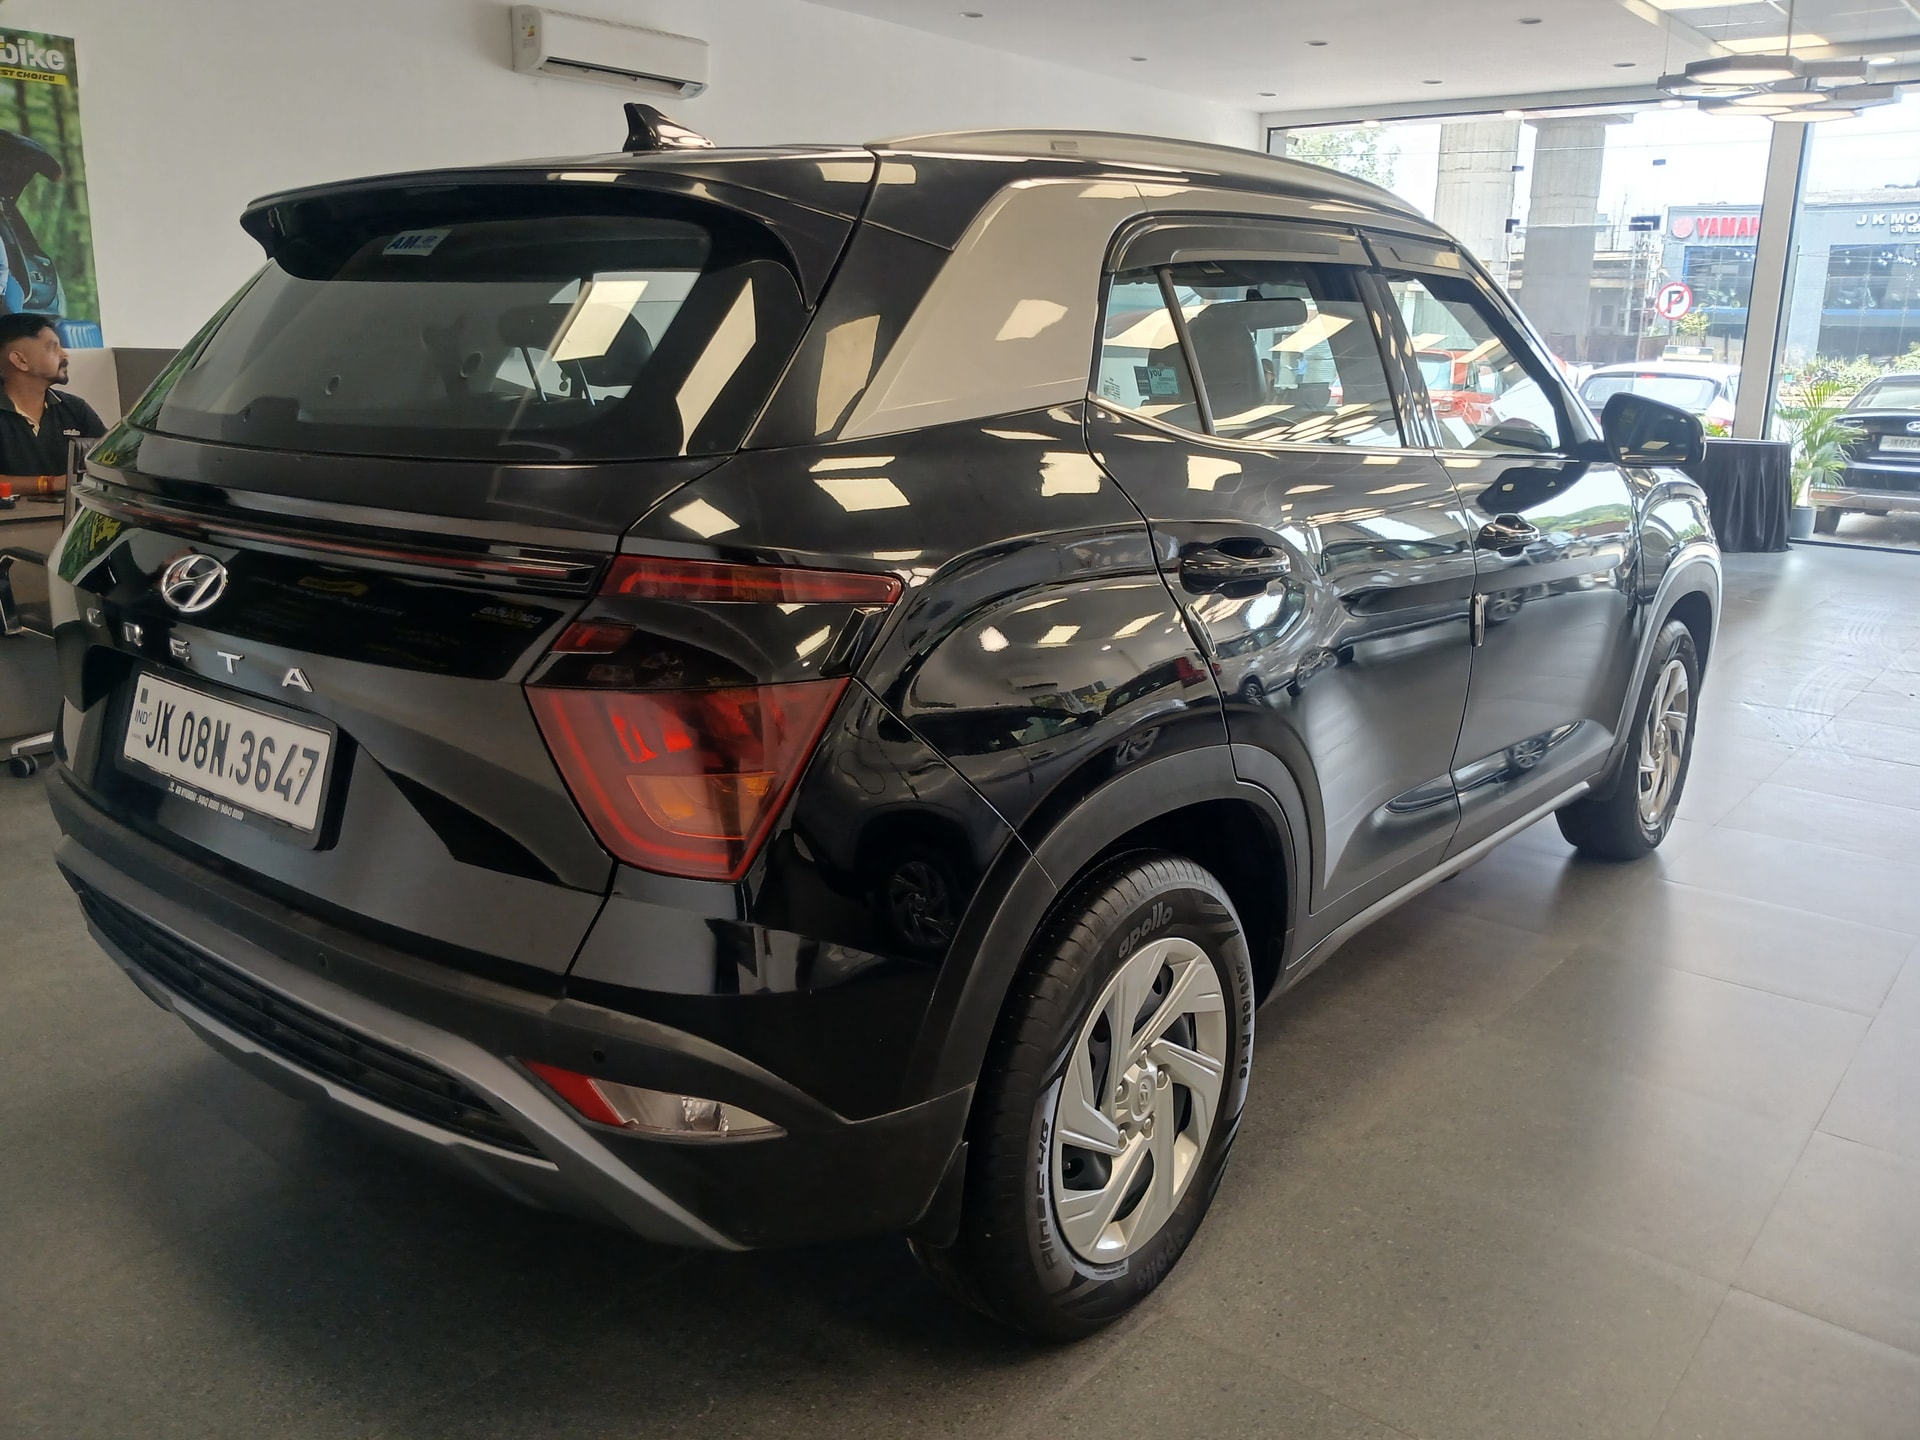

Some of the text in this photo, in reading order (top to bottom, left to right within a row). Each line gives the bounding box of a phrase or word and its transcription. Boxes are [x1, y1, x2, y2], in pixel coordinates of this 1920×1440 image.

[16, 71, 56, 82] CHOICE
[1856, 212, 1920, 226] J K MO
[1667, 289, 1685, 314] P
[86, 607, 314, 693] CRETA
[1118, 901, 1175, 959] apollo
